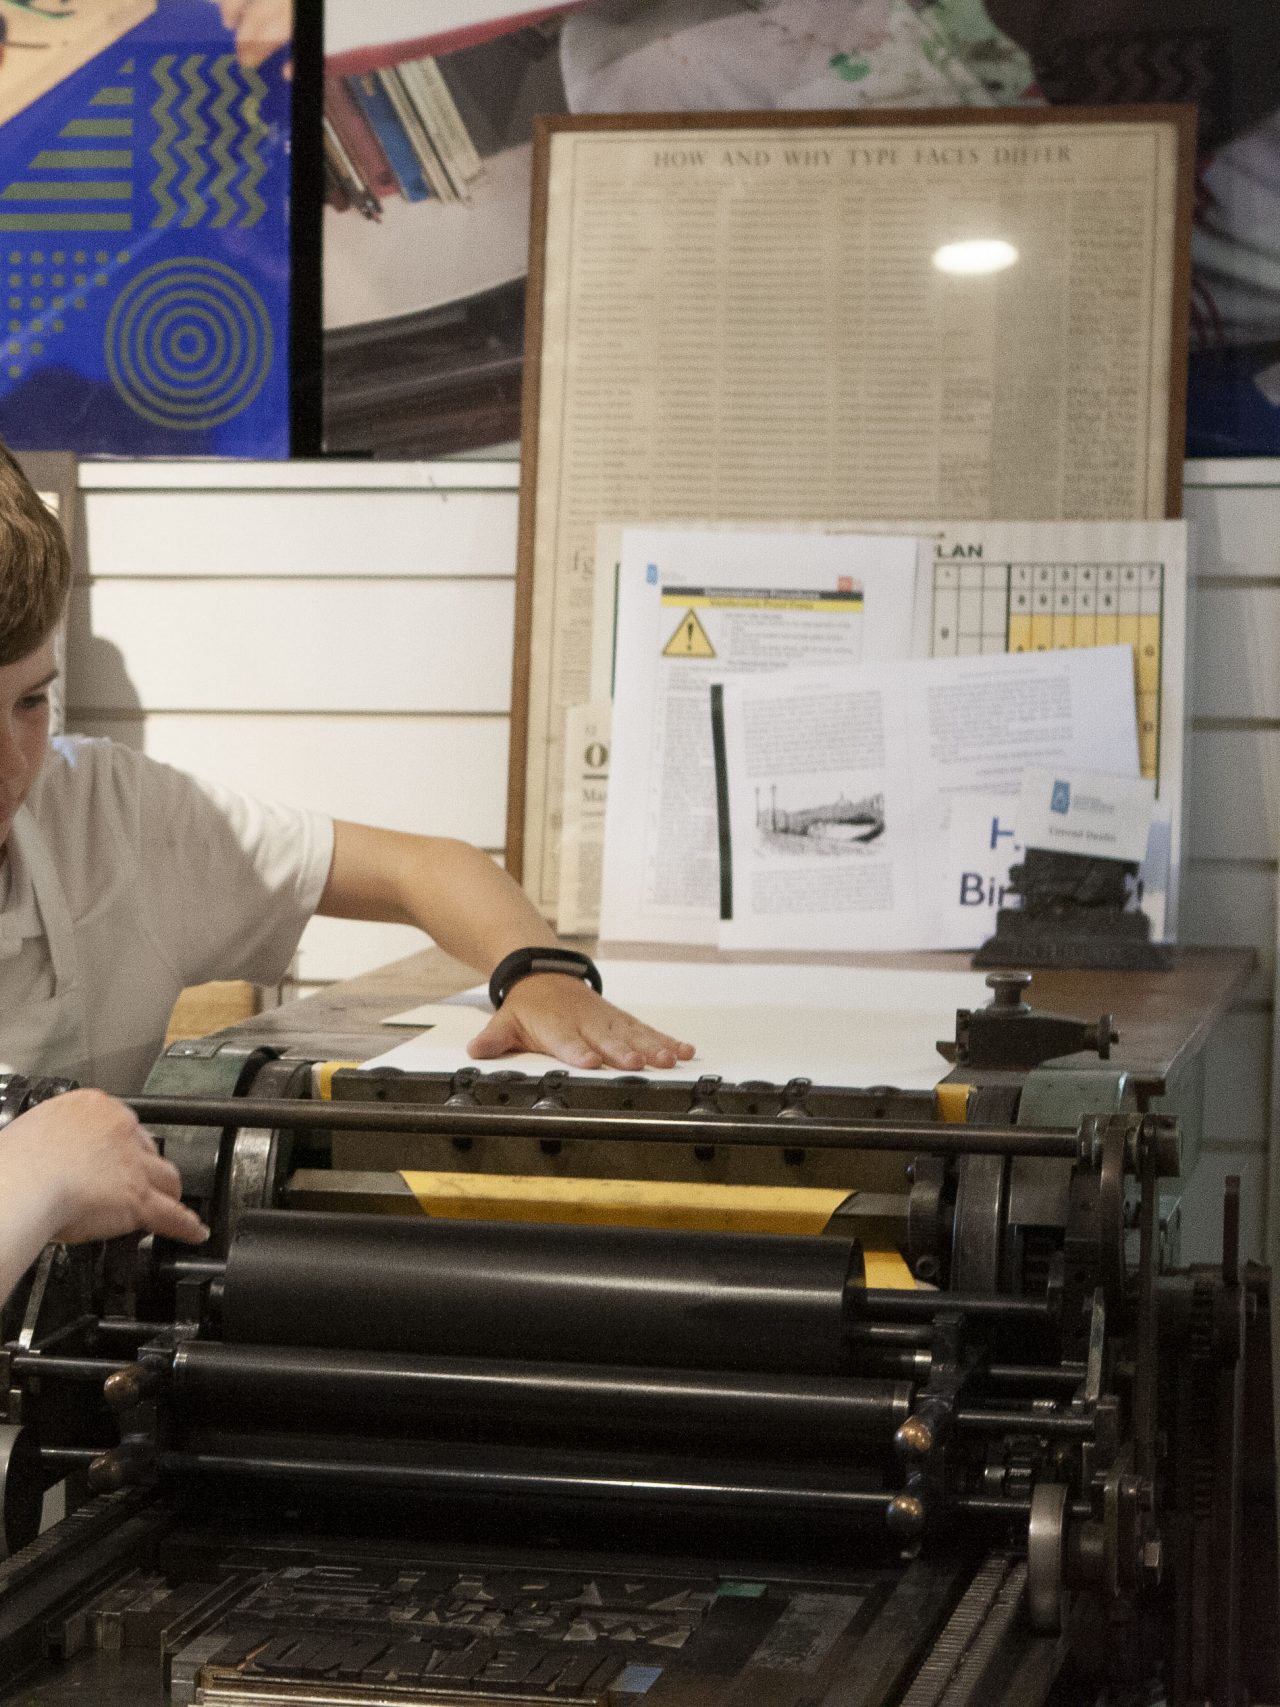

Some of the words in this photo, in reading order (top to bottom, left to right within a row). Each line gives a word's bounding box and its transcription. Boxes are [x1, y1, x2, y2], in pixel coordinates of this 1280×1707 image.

[654, 149, 705, 168] HOW
[722, 149, 770, 168] AND
[784, 148, 832, 167] WHY
[848, 147, 897, 166] TYPE
[914, 147, 977, 166] FACES
[993, 145, 1071, 166] DIFFER
[936, 543, 984, 559] LAN
